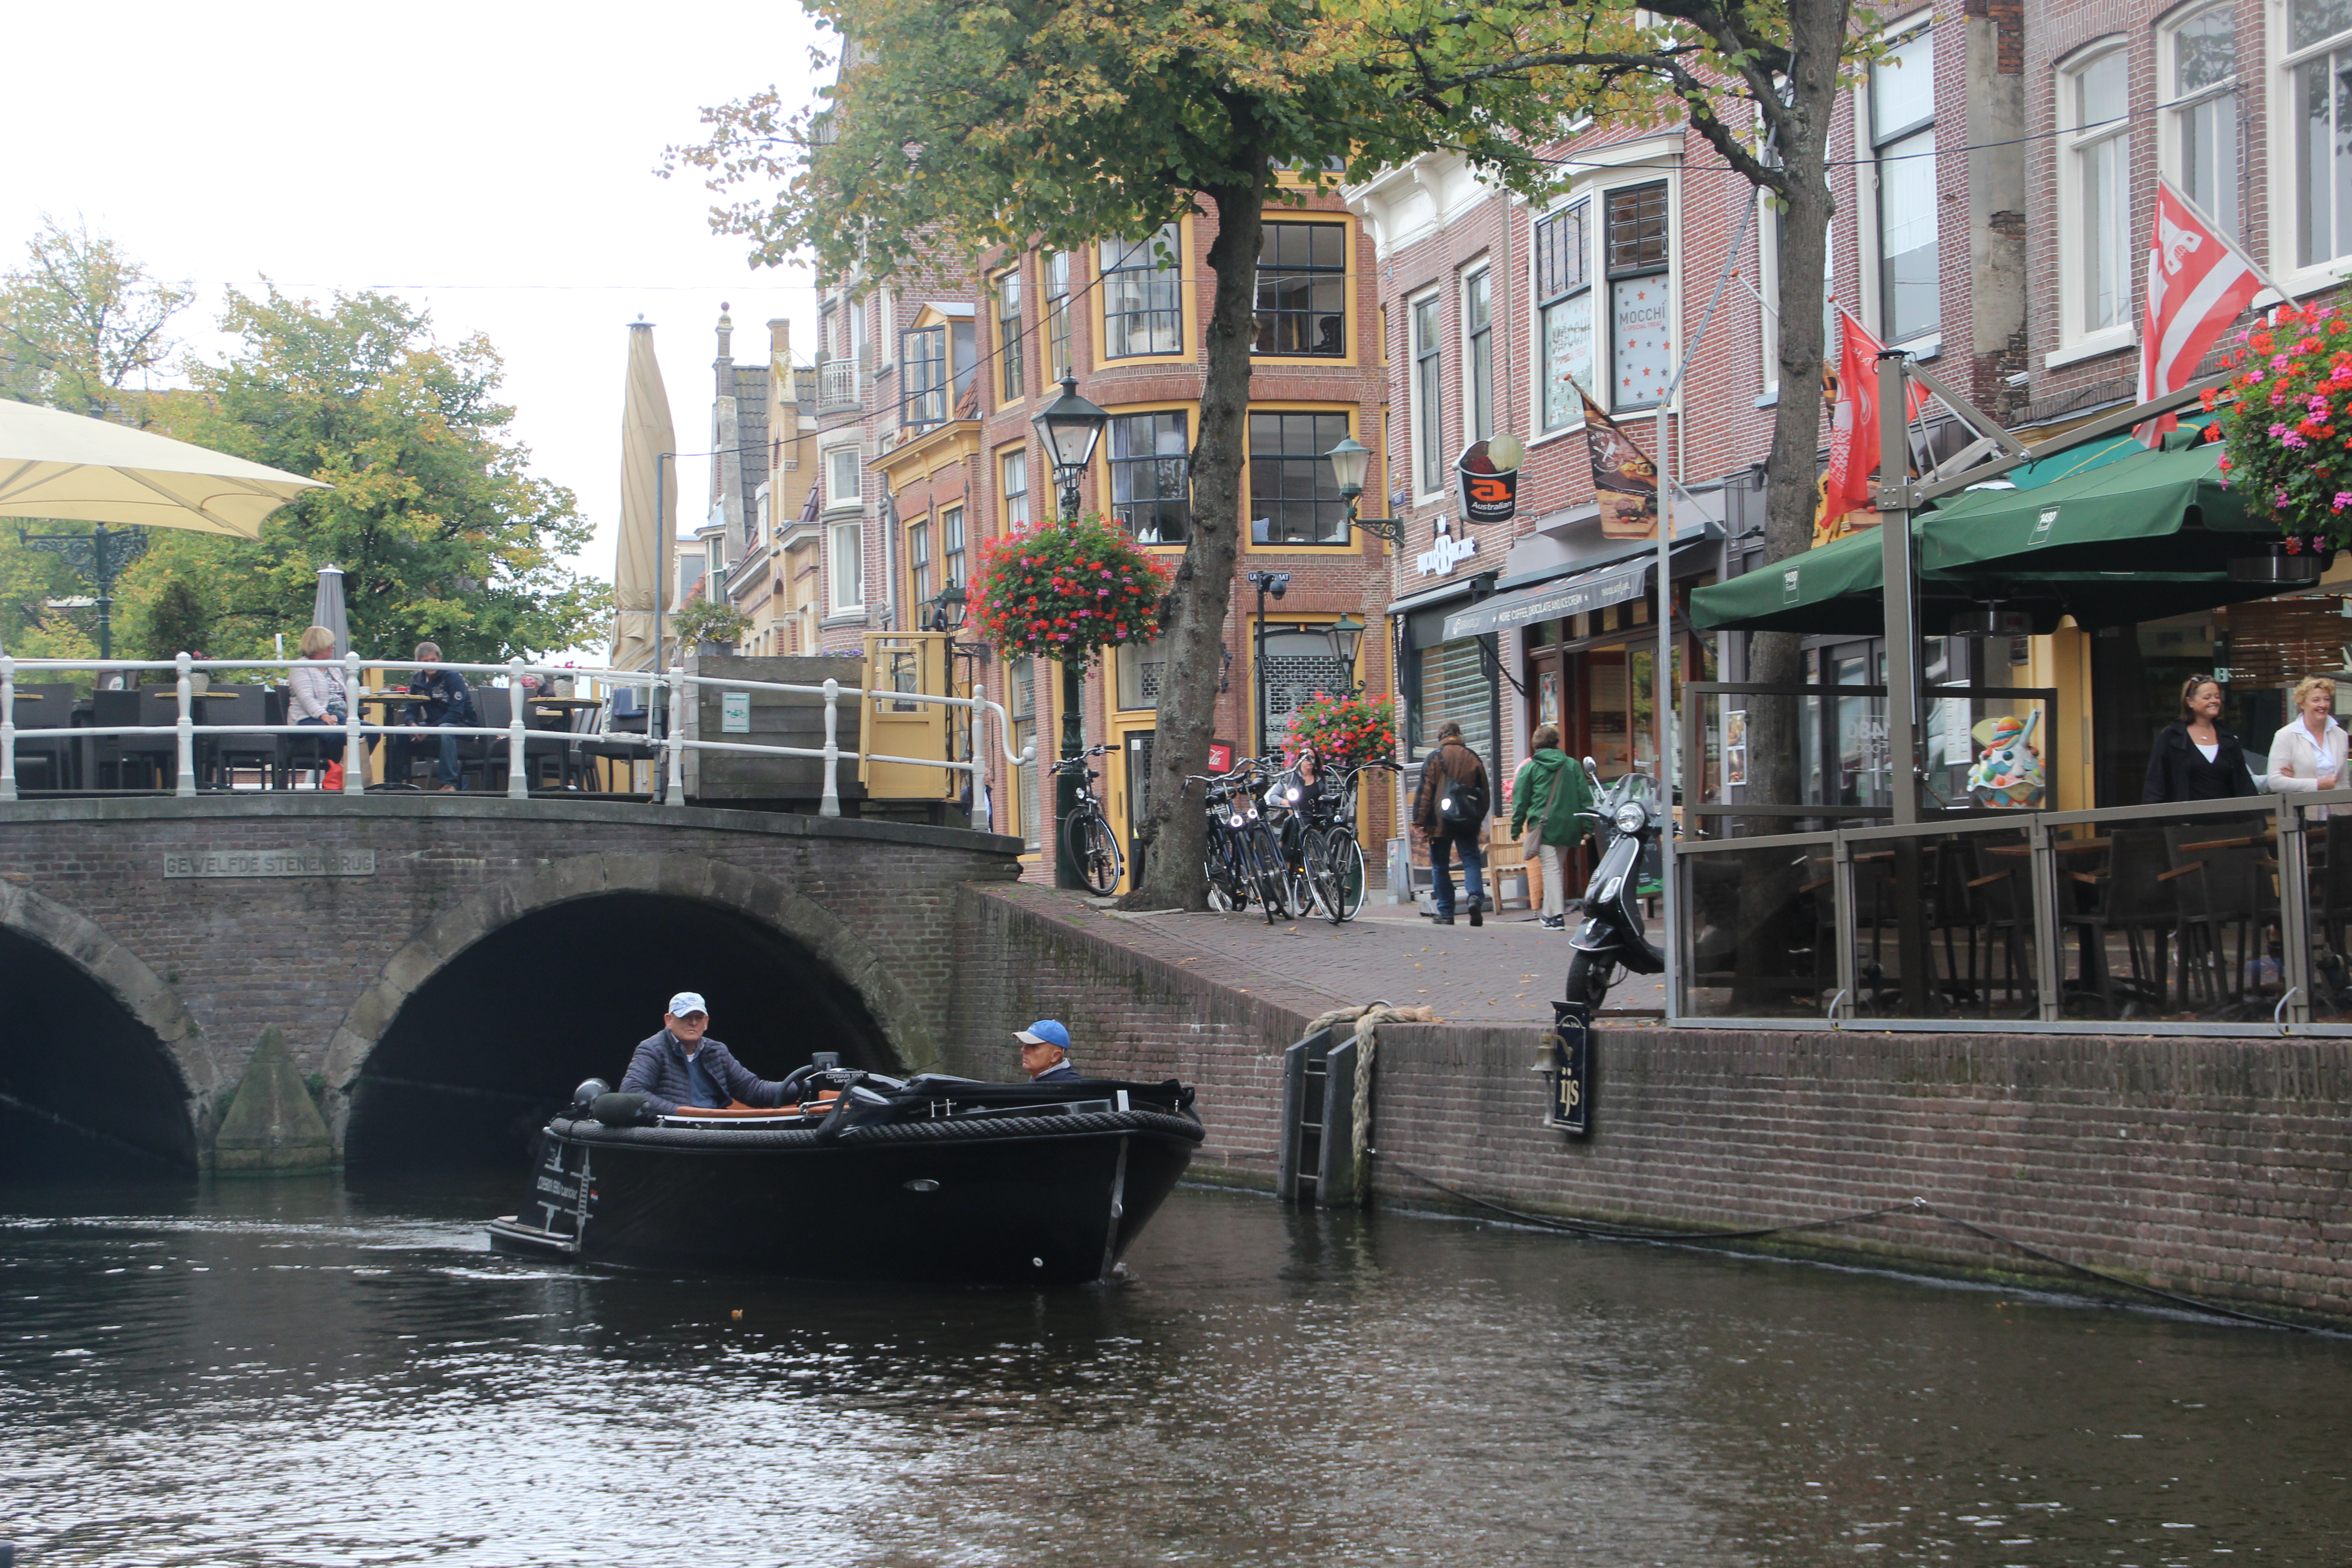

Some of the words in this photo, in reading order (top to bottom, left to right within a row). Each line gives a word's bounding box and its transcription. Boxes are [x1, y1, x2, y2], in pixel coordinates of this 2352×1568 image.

[1619, 305, 1665, 325] MOCCHI
[1471, 501, 1513, 510] Australian
[2038, 511, 2057, 524] 1480
[1784, 570, 1798, 583] 1480
[167, 856, 260, 873] GEWELFDE
